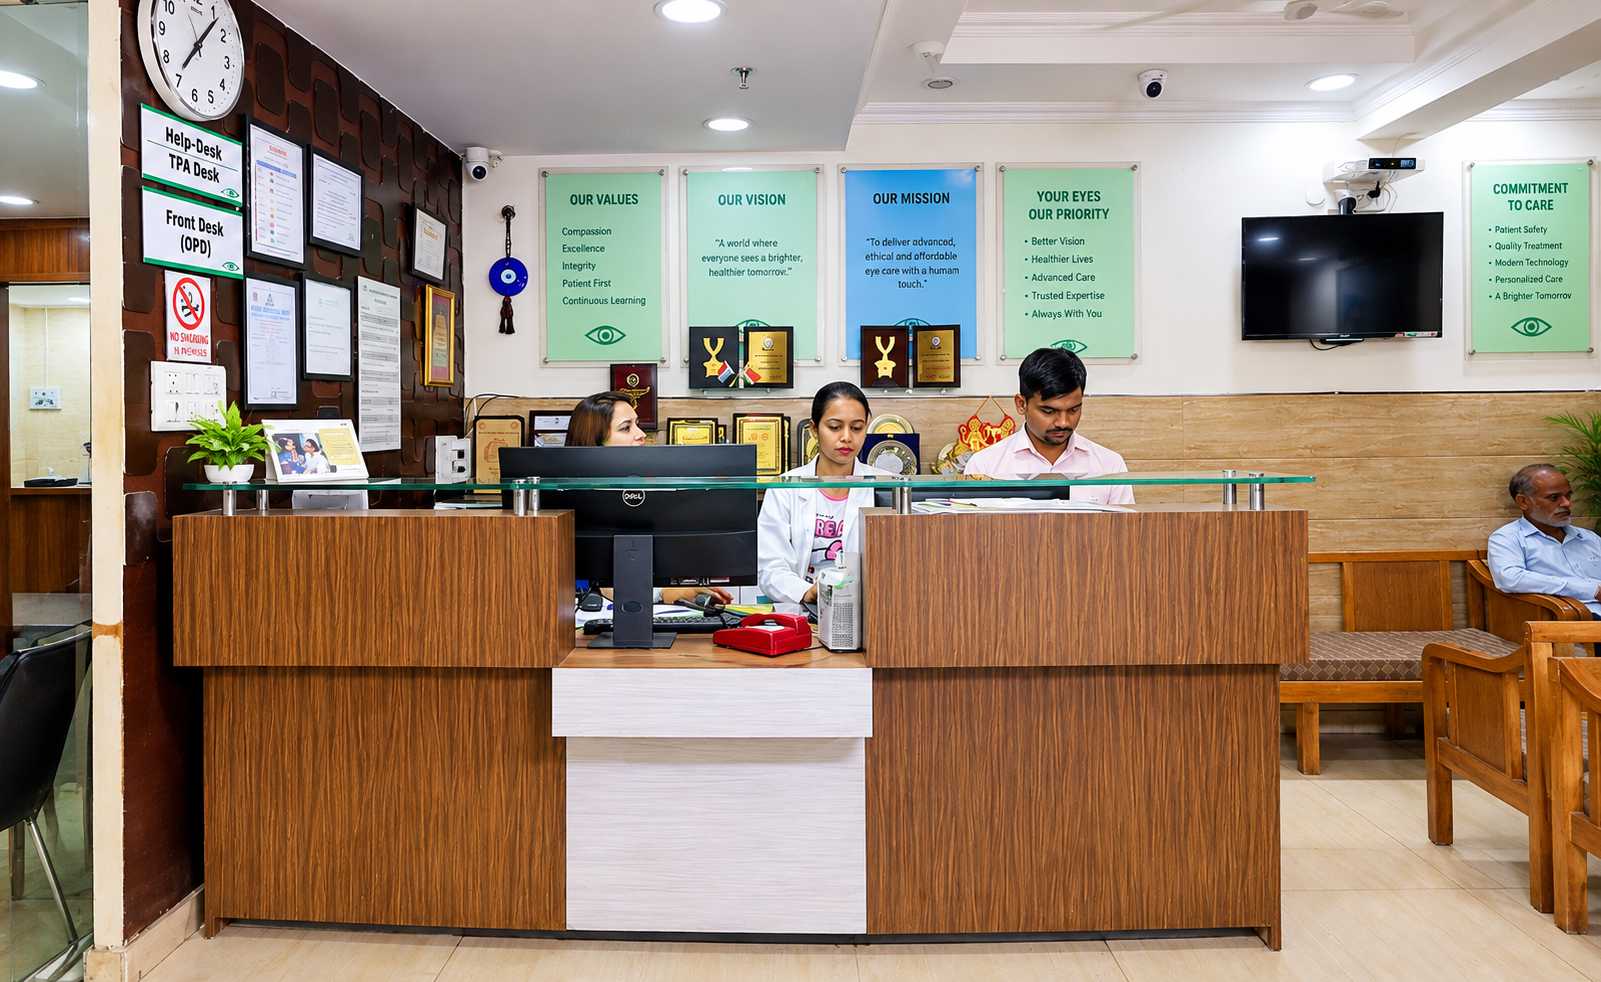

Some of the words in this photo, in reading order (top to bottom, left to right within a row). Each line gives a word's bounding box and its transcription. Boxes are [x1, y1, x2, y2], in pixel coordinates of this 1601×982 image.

[164, 0, 175, 15] 10
[210, 5, 216, 20] 1
[158, 20, 166, 36] 9
[220, 28, 227, 44] 2
[162, 49, 170, 64] 8
[223, 55, 230, 70] 3
[175, 73, 182, 88] 7
[219, 78, 226, 91] 4
[191, 88, 198, 103] 6
[207, 89, 214, 104] 5
[165, 126, 223, 162] Help-Desk
[168, 153, 191, 174] TPA
[193, 163, 220, 183] Desk
[1493, 182, 1569, 195] COMMITMENT
[569, 193, 594, 206] OUR
[595, 193, 639, 206] VALUES
[717, 193, 743, 206] OUR
[745, 193, 786, 206] VISION
[872, 192, 898, 205] OUR
[900, 191, 950, 205] MISSION
[1036, 190, 1070, 203] YOUR
[1072, 190, 1101, 203] EYES
[1507, 199, 1523, 211] TO
[1525, 199, 1554, 211] CARE
[1028, 208, 1053, 220] OUR
[1056, 207, 1110, 220] PRIORITY
[166, 209, 196, 230] Front
[198, 217, 224, 237] Desk
[1494, 225, 1522, 234] Patient
[1523, 224, 1548, 235] Safety
[561, 226, 612, 238] Compassion
[180, 234, 212, 258] (OPD)
[726, 238, 751, 247] world
[881, 237, 911, 247] deliver
[1031, 236, 1058, 246] Better
[1059, 236, 1085, 246] Vision
[1523, 241, 1563, 250] Treatment
[561, 243, 606, 253] Excellence
[701, 254, 739, 265] everyone
[740, 254, 759, 263] sees
[760, 254, 767, 263] a
[767, 252, 804, 265] brighter,
[864, 251, 894, 261] ethical
[895, 251, 913, 261] and
[913, 251, 958, 261] affordable
[1031, 254, 1070, 264] Healthier
[1071, 254, 1094, 264] Lives
[561, 260, 597, 273] Integrity
[1494, 258, 1524, 267] Modern
[1524, 257, 1569, 269] Technology
[708, 267, 746, 277] healthier
[864, 268, 881, 278] eye
[881, 268, 900, 276] care
[901, 266, 920, 275] with
[921, 267, 927, 275] a
[1031, 272, 1074, 282] Advanced
[1075, 272, 1096, 282] Care
[561, 278, 592, 288] Patient
[593, 278, 612, 288] First
[1494, 274, 1544, 284] Personalized
[1544, 274, 1564, 283] Care
[561, 296, 609, 306] Continuous
[610, 295, 647, 307] Learning
[1031, 290, 1064, 301] Trusted
[1066, 290, 1106, 302] Expertise
[1494, 292, 1501, 301] A
[1502, 291, 1534, 303] Brighter
[1031, 309, 1063, 320] Always
[1063, 309, 1084, 318] With
[1085, 309, 1103, 318] You
[169, 331, 180, 342] NO
